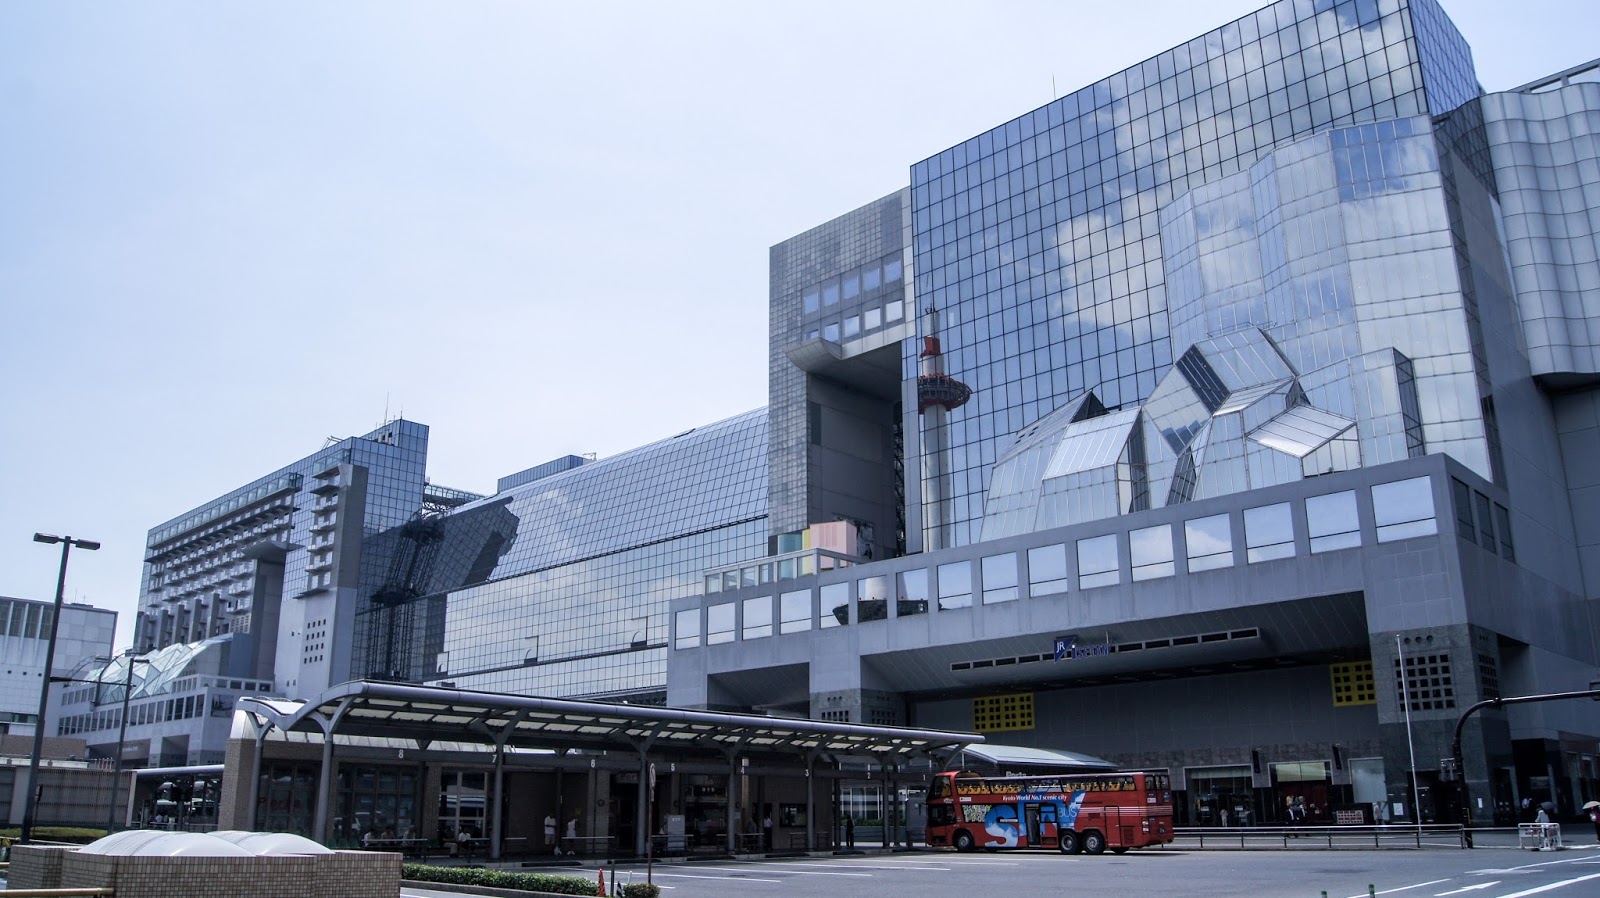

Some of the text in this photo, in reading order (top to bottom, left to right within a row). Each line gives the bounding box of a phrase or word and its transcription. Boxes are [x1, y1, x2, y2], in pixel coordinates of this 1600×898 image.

[1056, 641, 1066, 653] JR
[398, 749, 404, 759] 8
[492, 754, 498, 763] 7
[590, 759, 596, 768] 6
[670, 763, 676, 772] 5
[740, 766, 745, 774] 4
[804, 768, 810, 777] 3
[866, 771, 871, 780] 2
[1057, 793, 1067, 801] city
[1058, 807, 1077, 818] BUS
